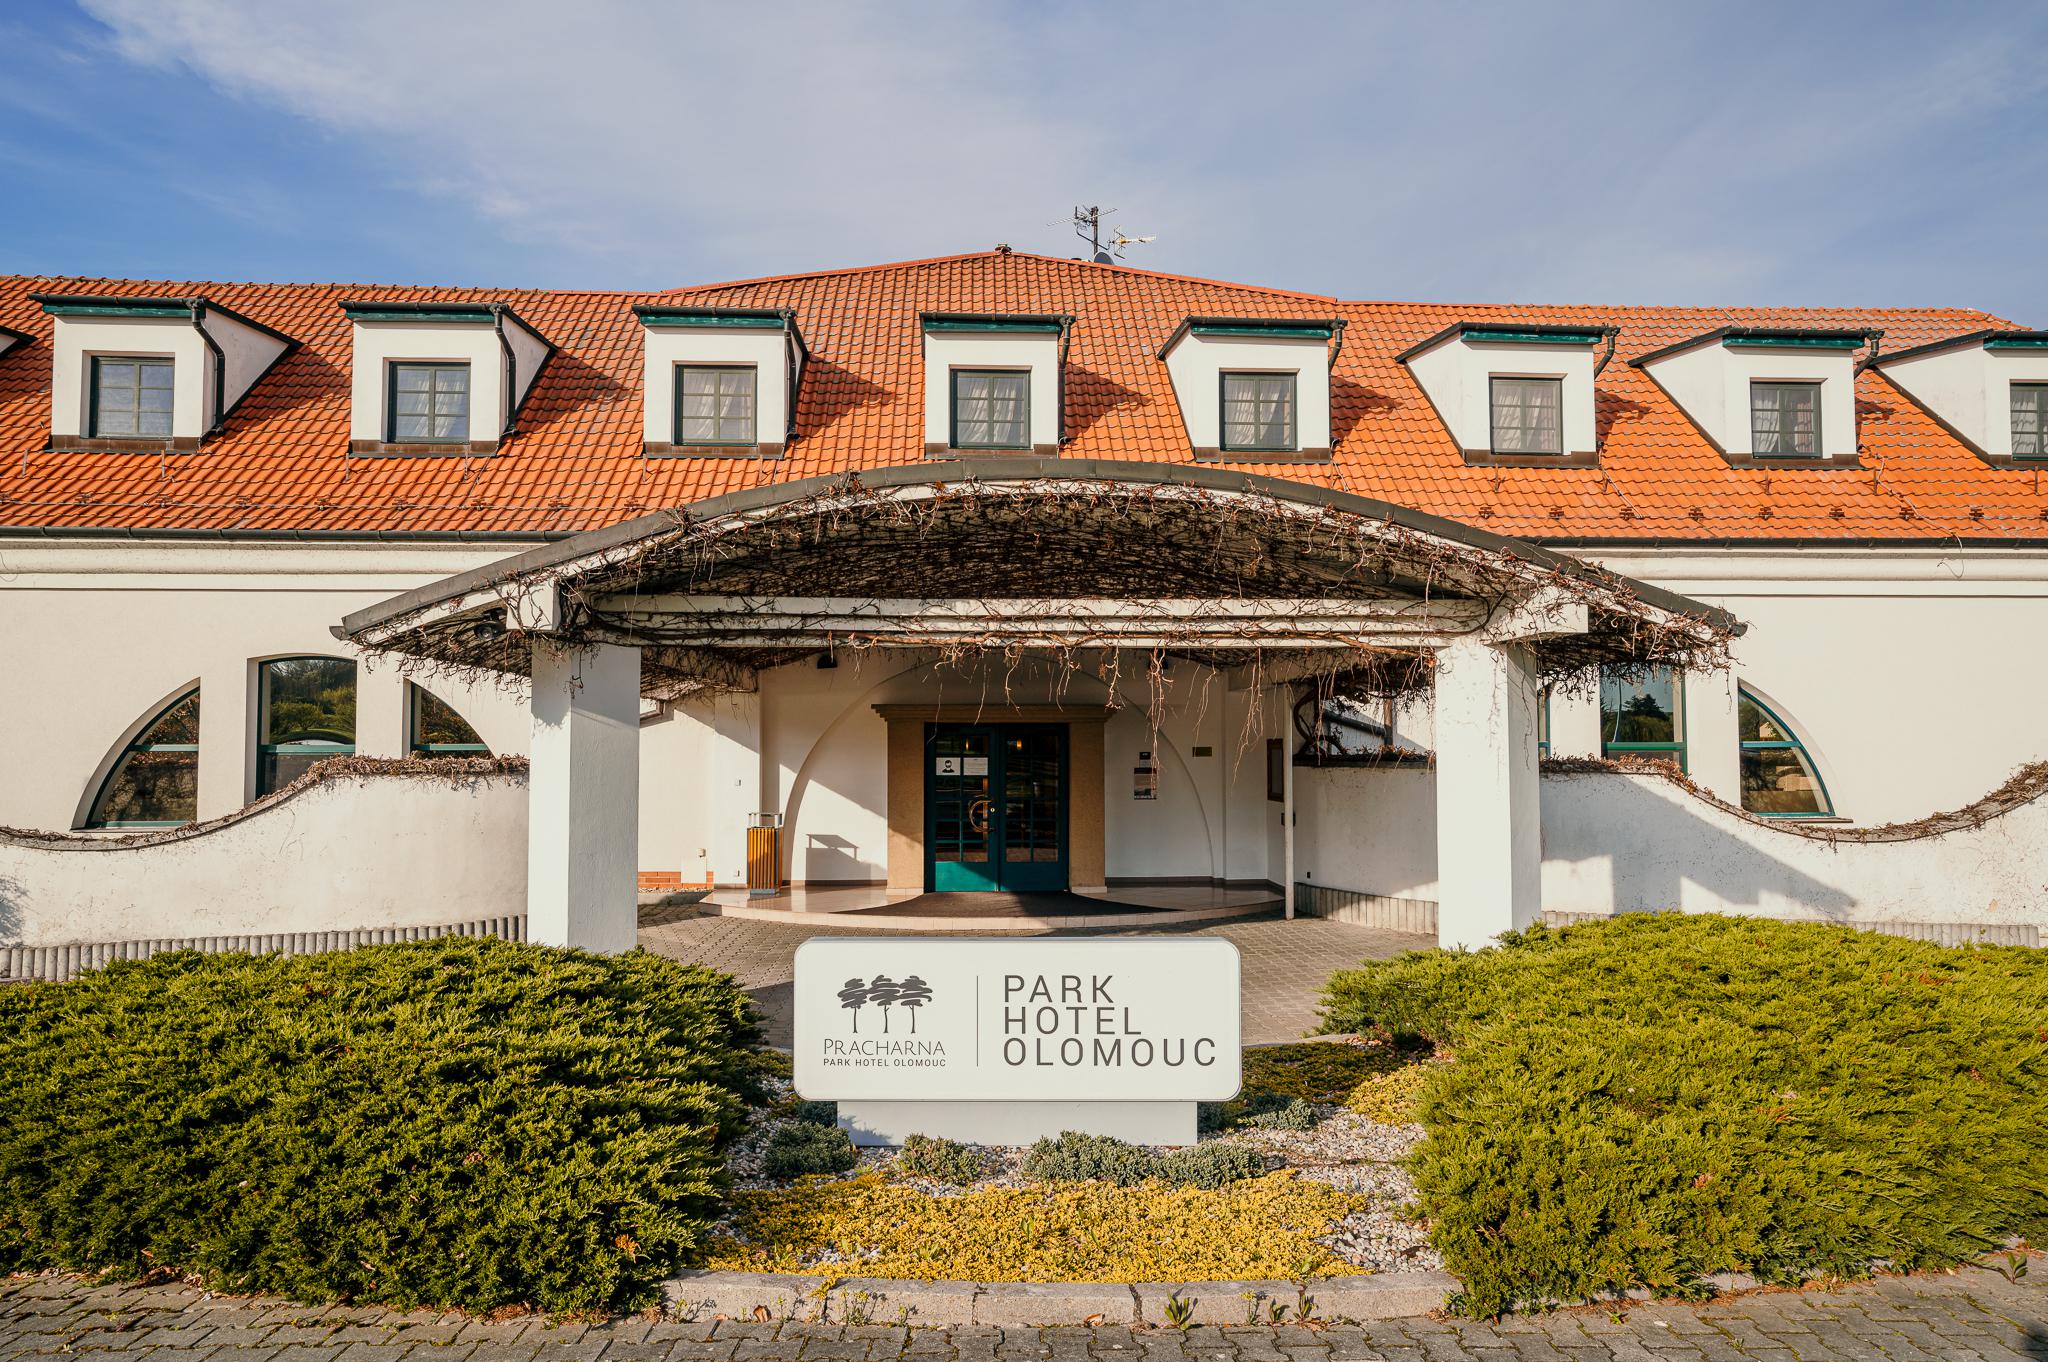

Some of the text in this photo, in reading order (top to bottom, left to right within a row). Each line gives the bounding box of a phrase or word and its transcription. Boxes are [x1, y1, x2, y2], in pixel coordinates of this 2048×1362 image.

[1004, 974, 1114, 1003] PARK
[1004, 1006, 1142, 1035] HOTEL
[823, 1038, 946, 1056] PRACHARNA
[1003, 1037, 1216, 1067] OLOMOUC
[823, 1058, 946, 1067] PARK HOTEL OLOMOUC
